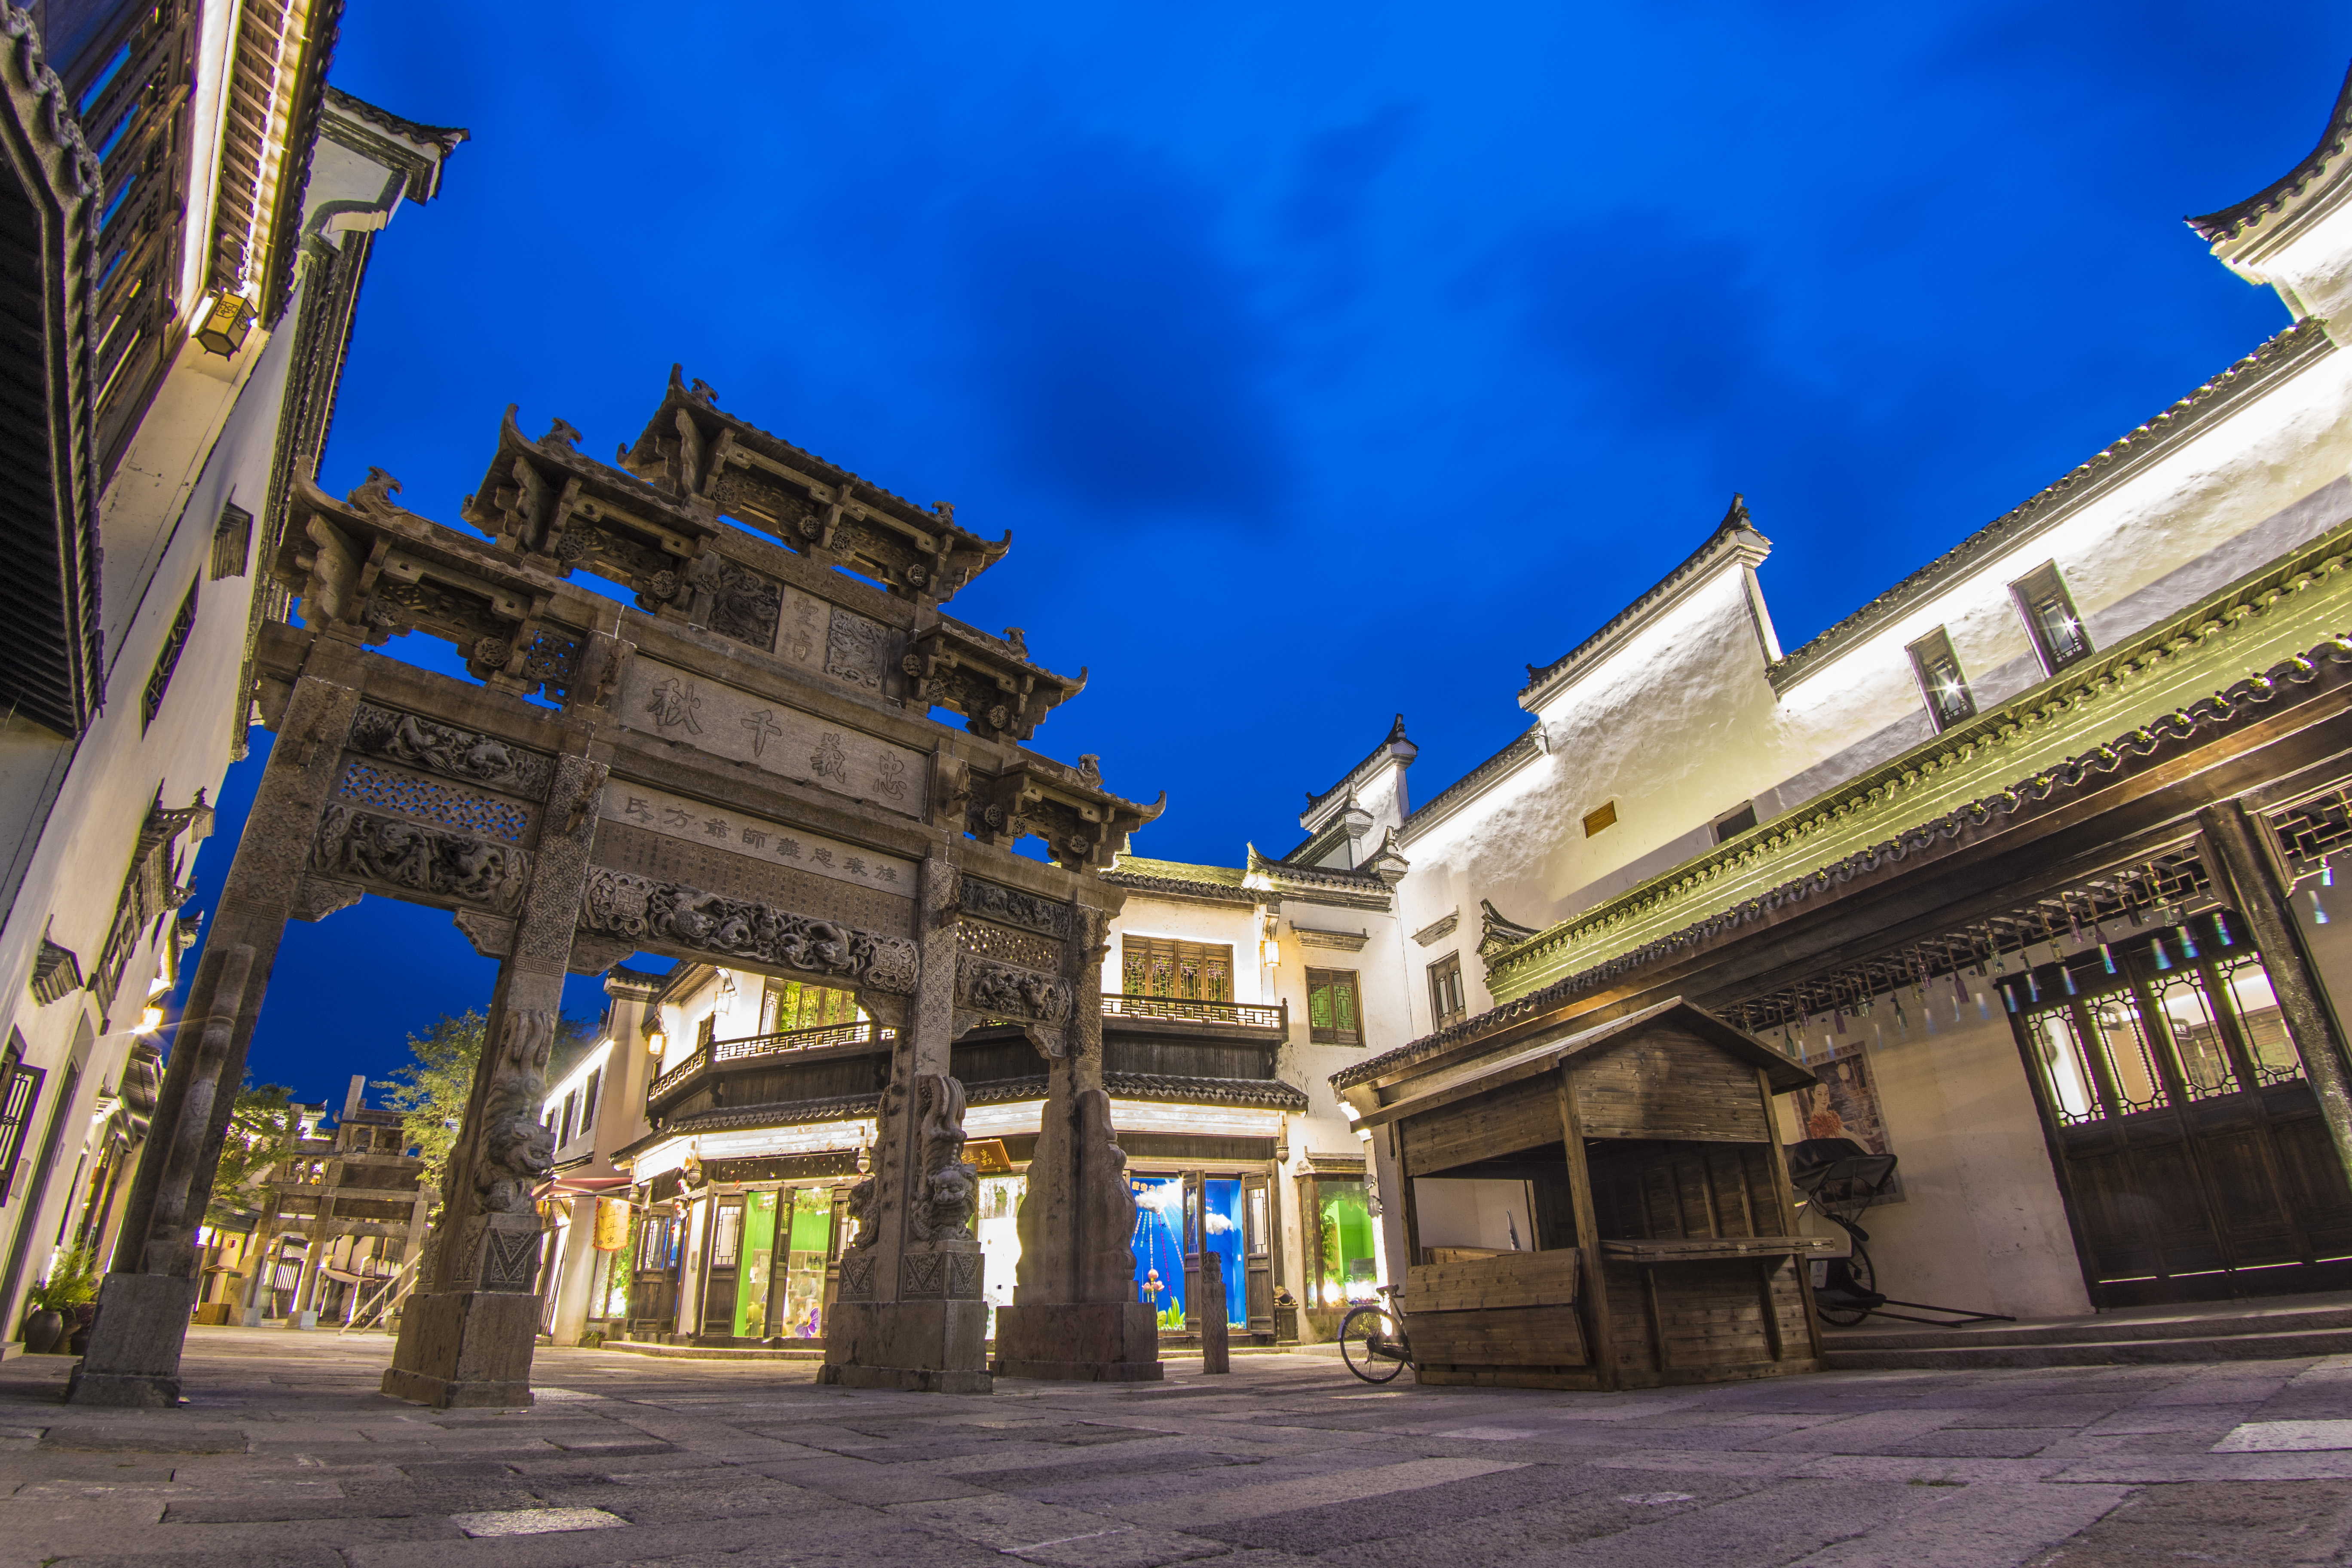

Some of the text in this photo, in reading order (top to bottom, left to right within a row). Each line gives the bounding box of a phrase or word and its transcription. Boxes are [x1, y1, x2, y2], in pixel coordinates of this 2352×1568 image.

[787, 597, 818, 660] 聖旨
[647, 678, 906, 800] 忠義千秋
[607, 1210, 618, 1243] 斗斗虫
